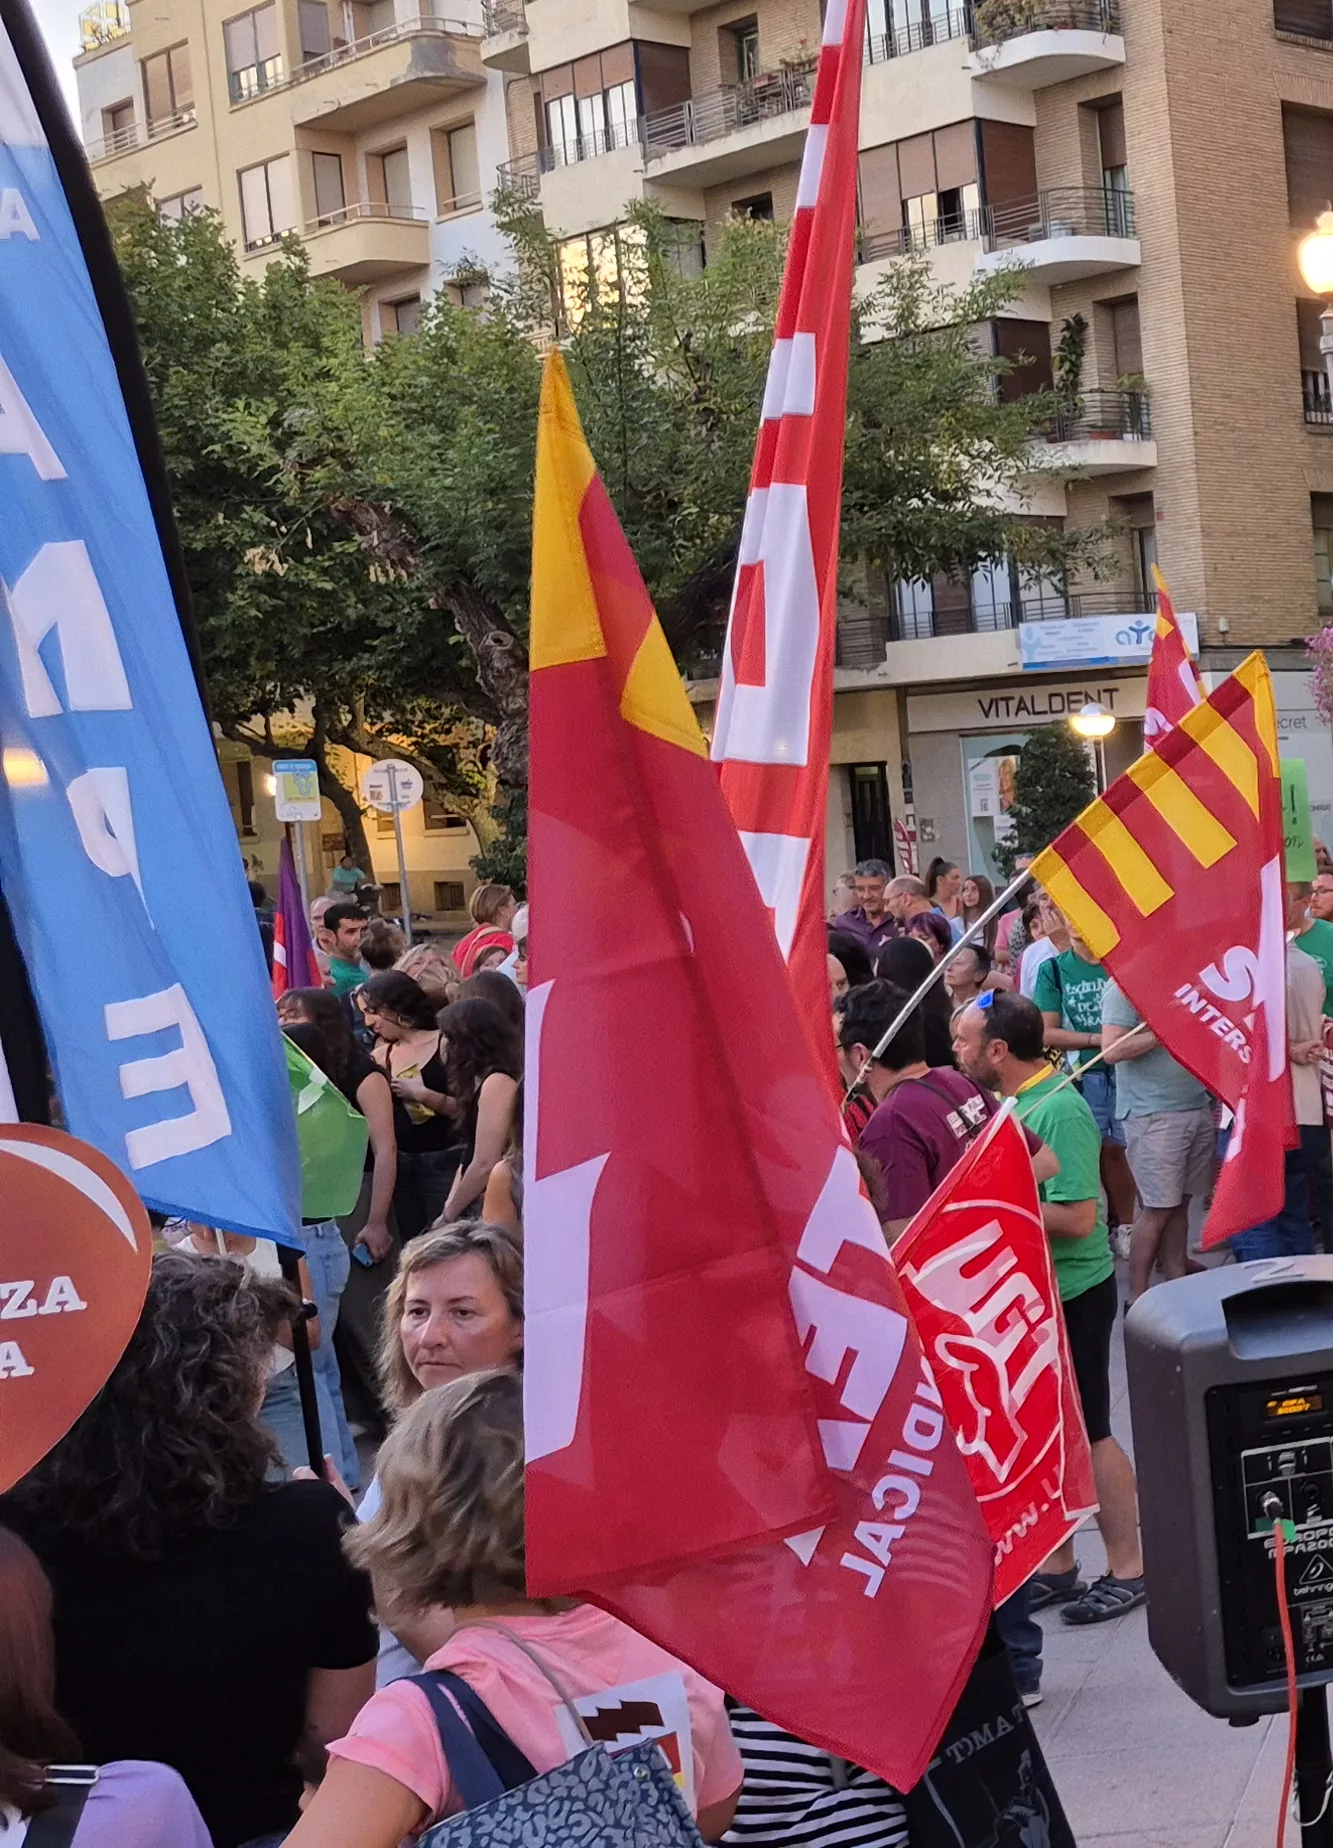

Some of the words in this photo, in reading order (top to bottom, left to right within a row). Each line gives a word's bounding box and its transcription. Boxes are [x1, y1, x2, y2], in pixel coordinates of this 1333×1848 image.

[978, 687, 1120, 718] VITALDENT
[1173, 982, 1254, 1065] INTERS
[0, 1275, 87, 1319] ZA
[912, 1218, 1060, 1415] UGT
[0, 1341, 35, 1379] A
